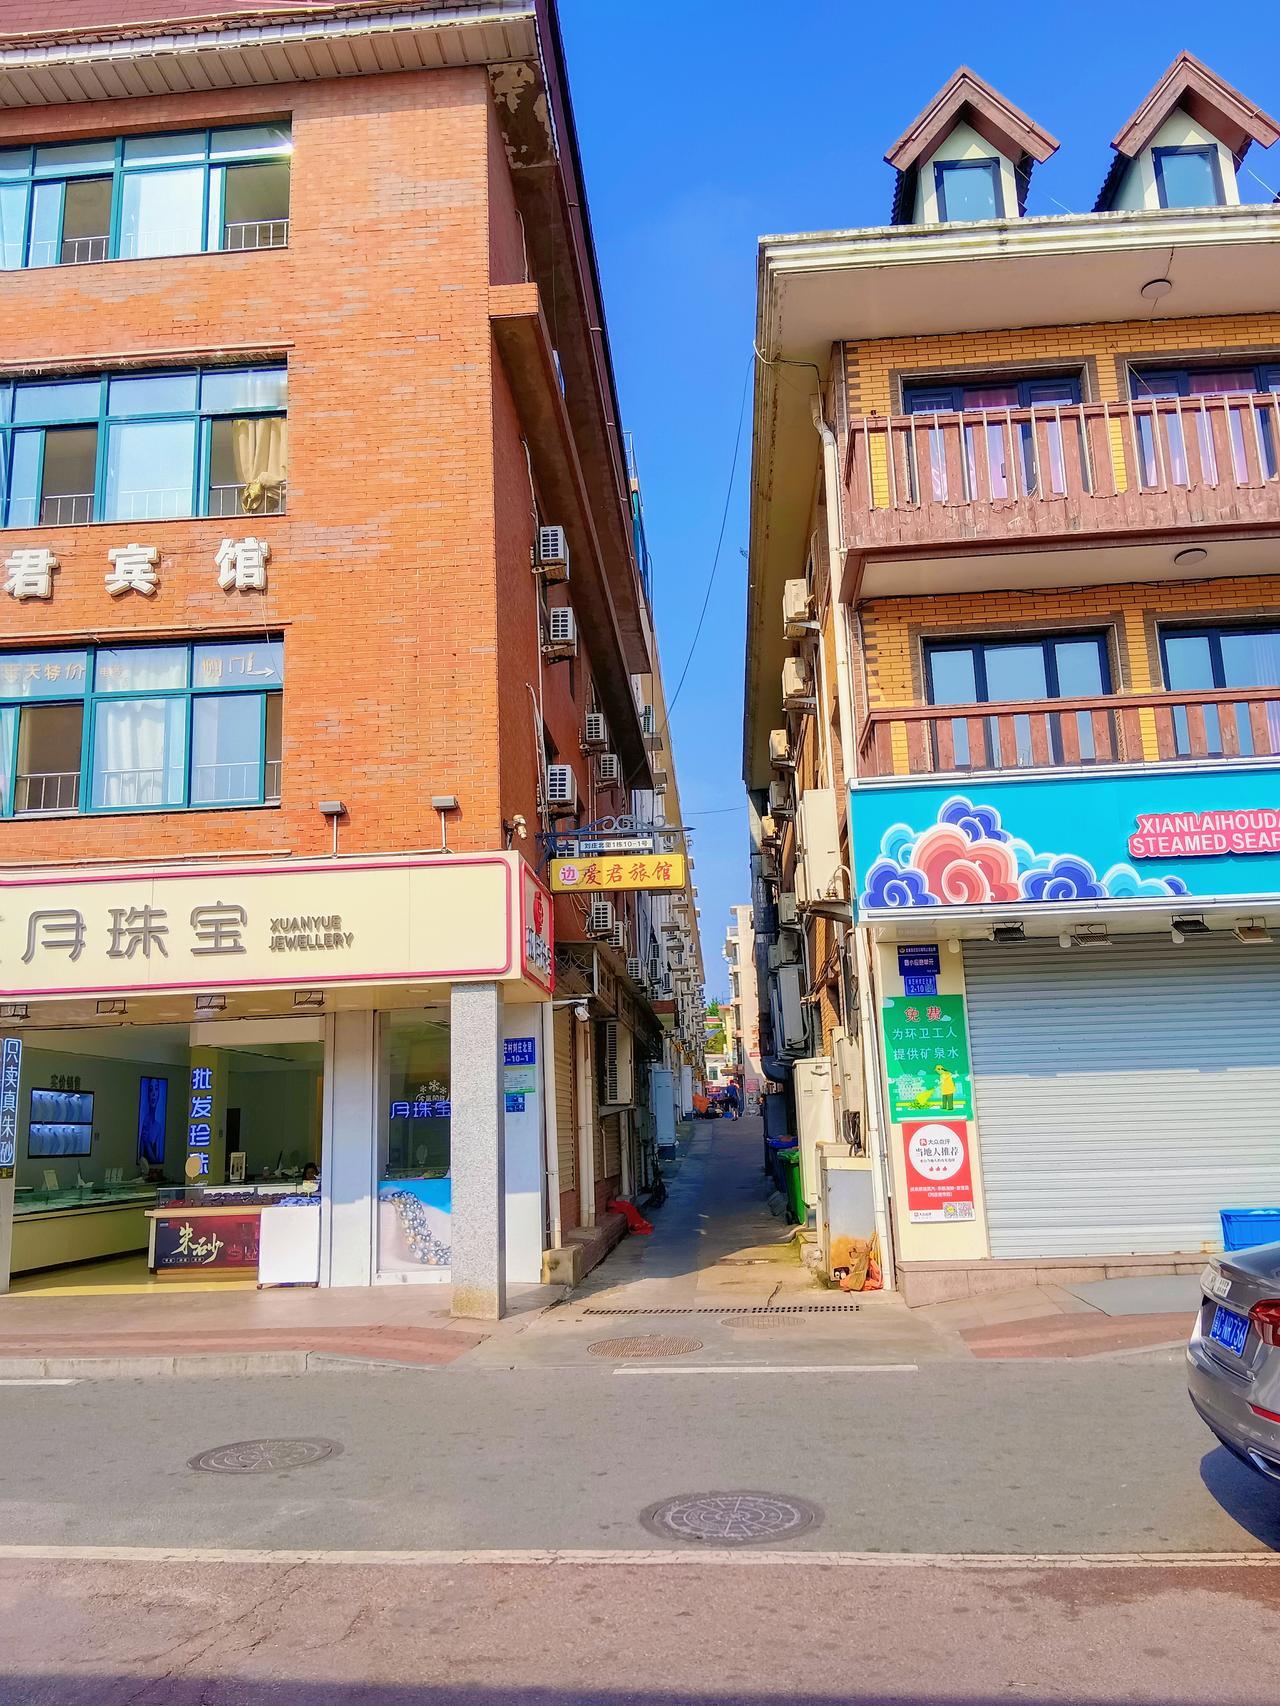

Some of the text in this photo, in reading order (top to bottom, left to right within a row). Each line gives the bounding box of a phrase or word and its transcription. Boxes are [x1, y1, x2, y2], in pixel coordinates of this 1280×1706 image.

[1142, 813, 1280, 834] XIANLAIHOUD
[1132, 834, 1227, 853] STEAMED
[0, 900, 247, 964] 月珠宝
[269, 914, 342, 933] XUANYUE
[268, 932, 354, 952] JEWELLERY
[904, 1006, 941, 1022] 免费
[892, 1026, 958, 1040] 为环卫工人
[893, 1046, 959, 1060] 提供矿泉水
[0, 1041, 18, 1163] 只卖真朱砂
[915, 1146, 960, 1157] 当地人推荐
[170, 1222, 224, 1264] 朱砂
